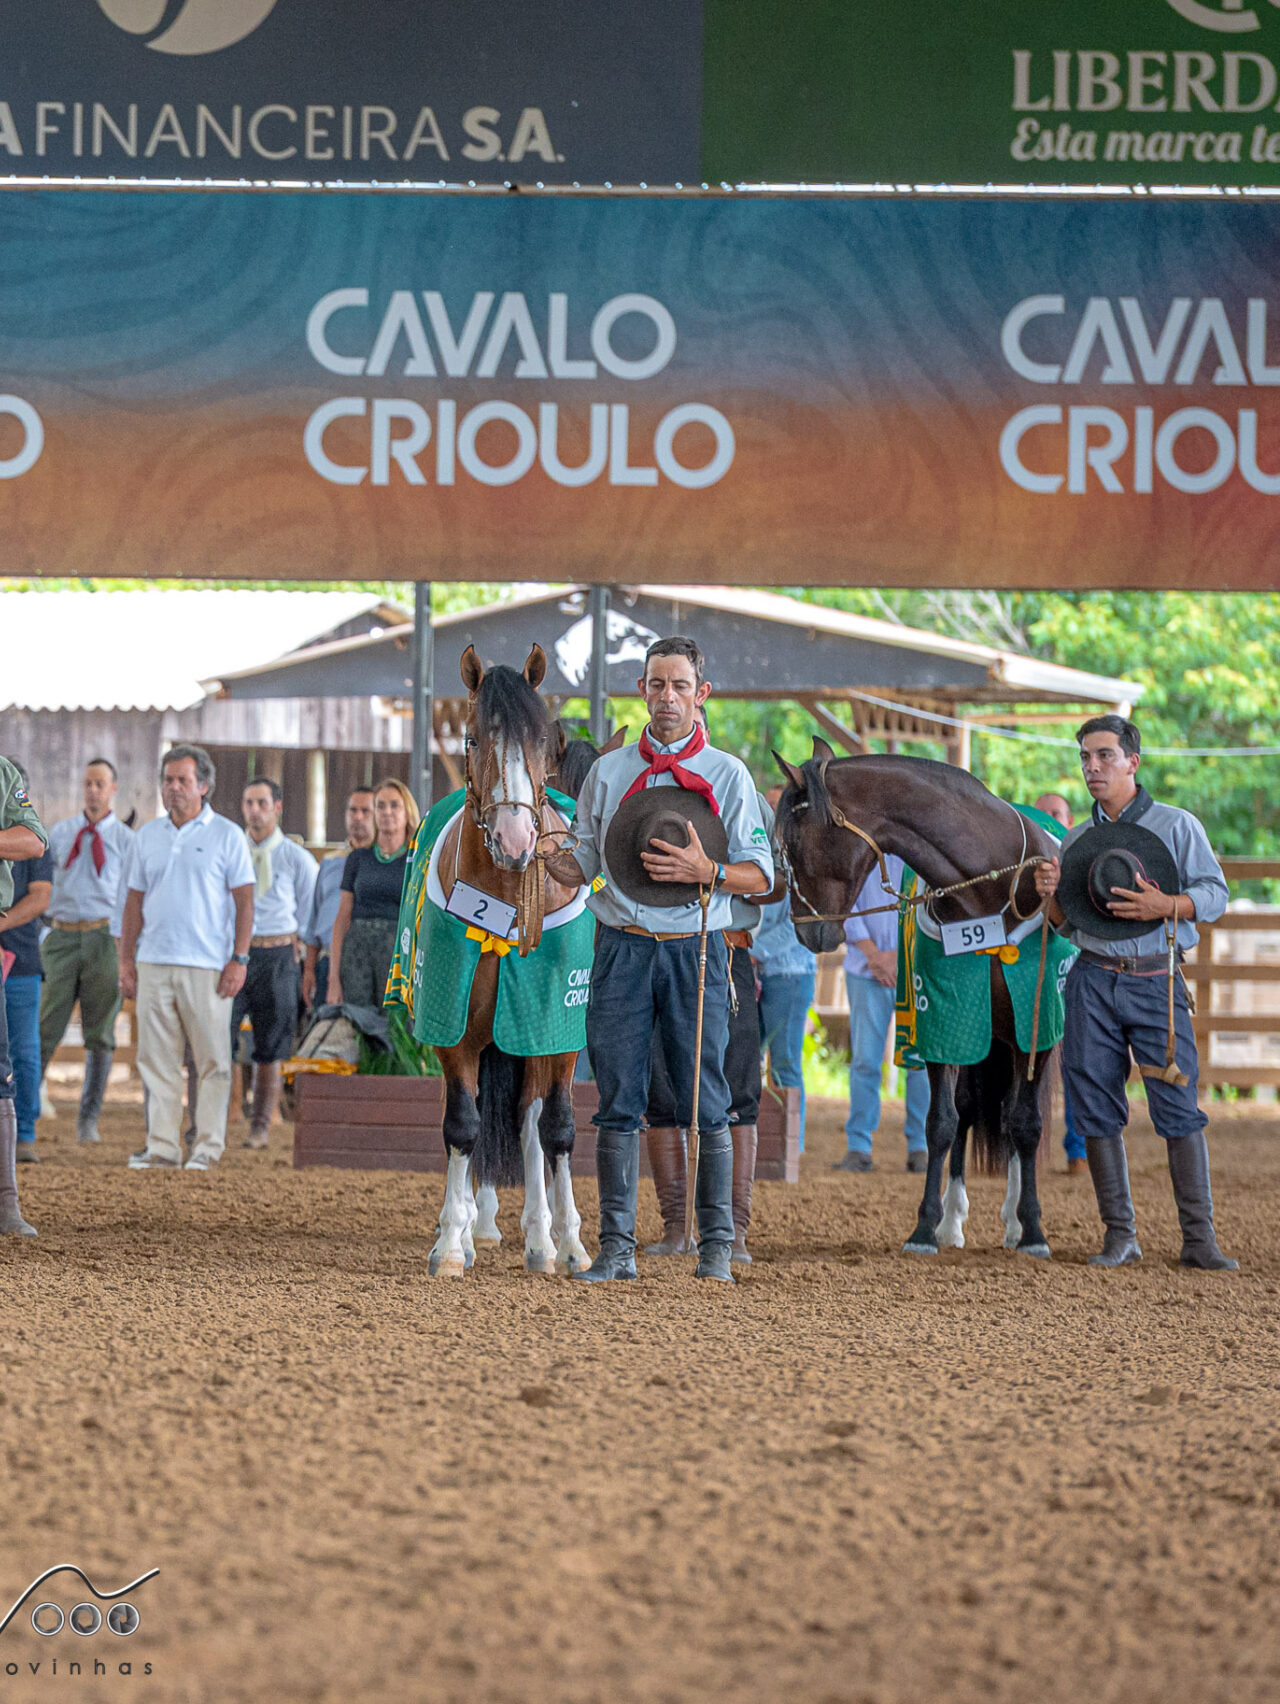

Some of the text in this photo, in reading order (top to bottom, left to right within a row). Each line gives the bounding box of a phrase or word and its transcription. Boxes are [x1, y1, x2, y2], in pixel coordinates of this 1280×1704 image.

[1012, 50, 1280, 114] LIBERD
[35, 102, 452, 161] FINANCEIRA
[462, 105, 567, 164] S.A.
[1010, 117, 1098, 162] Esta
[1104, 129, 1244, 163] marca
[304, 286, 679, 383] CAVALO
[302, 396, 738, 491] CRIOULO
[472, 899, 489, 921] 2
[961, 924, 986, 947] 59
